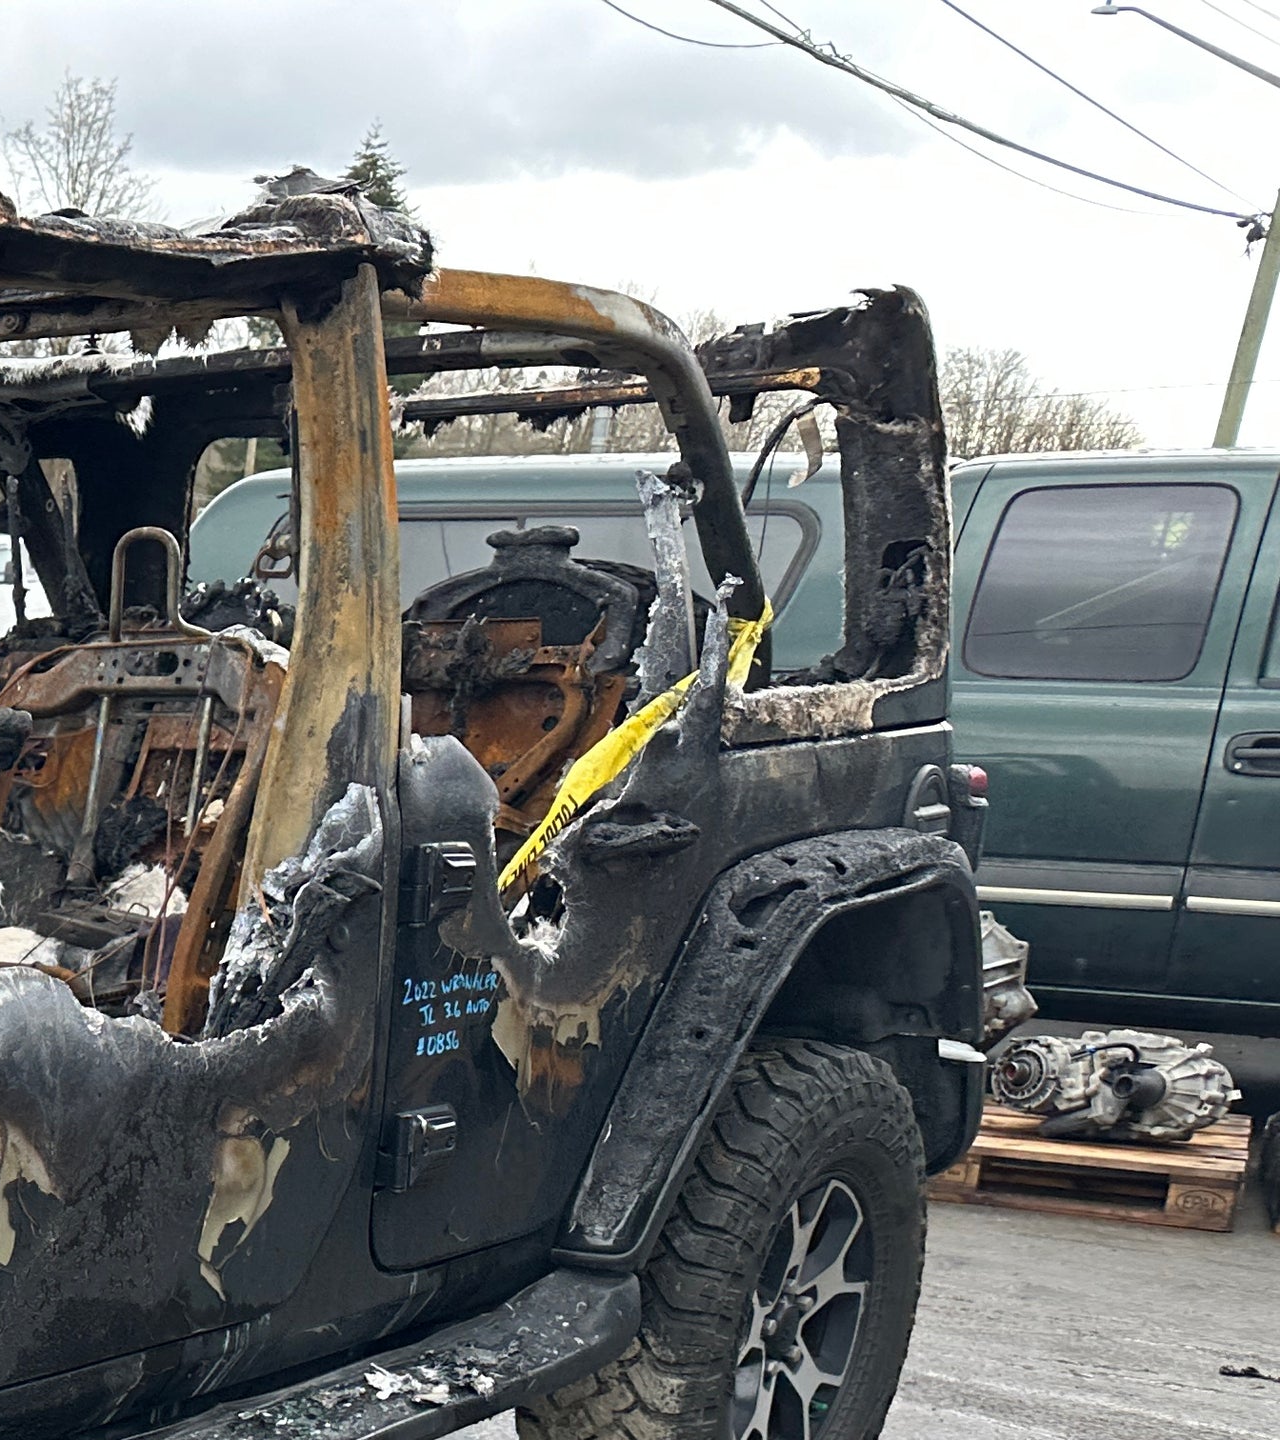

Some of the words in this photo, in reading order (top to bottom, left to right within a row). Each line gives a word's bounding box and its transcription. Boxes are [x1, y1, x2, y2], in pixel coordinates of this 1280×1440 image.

[403, 978, 437, 1005] 2022
[419, 1004, 436, 1026] JL
[466, 998, 491, 1014] AUTO
